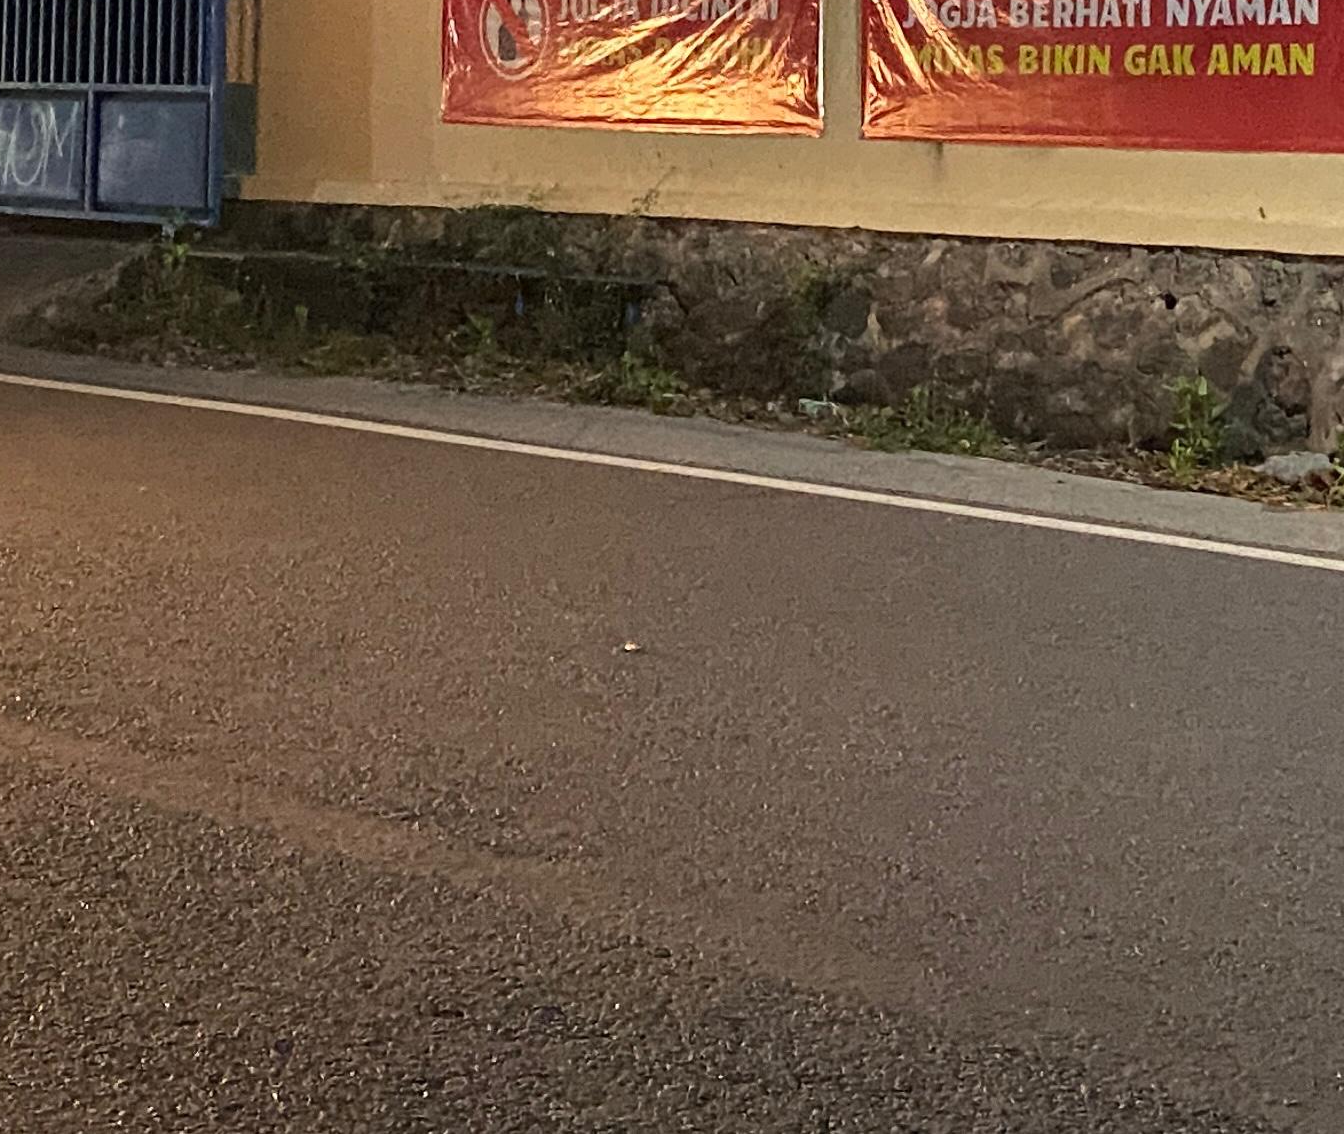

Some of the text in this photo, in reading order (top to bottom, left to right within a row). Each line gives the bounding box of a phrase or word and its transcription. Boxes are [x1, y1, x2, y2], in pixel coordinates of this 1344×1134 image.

[1018, 44, 1111, 75] BIKIN
[1124, 43, 1197, 76] GAK
[1207, 42, 1316, 76] AMAN
